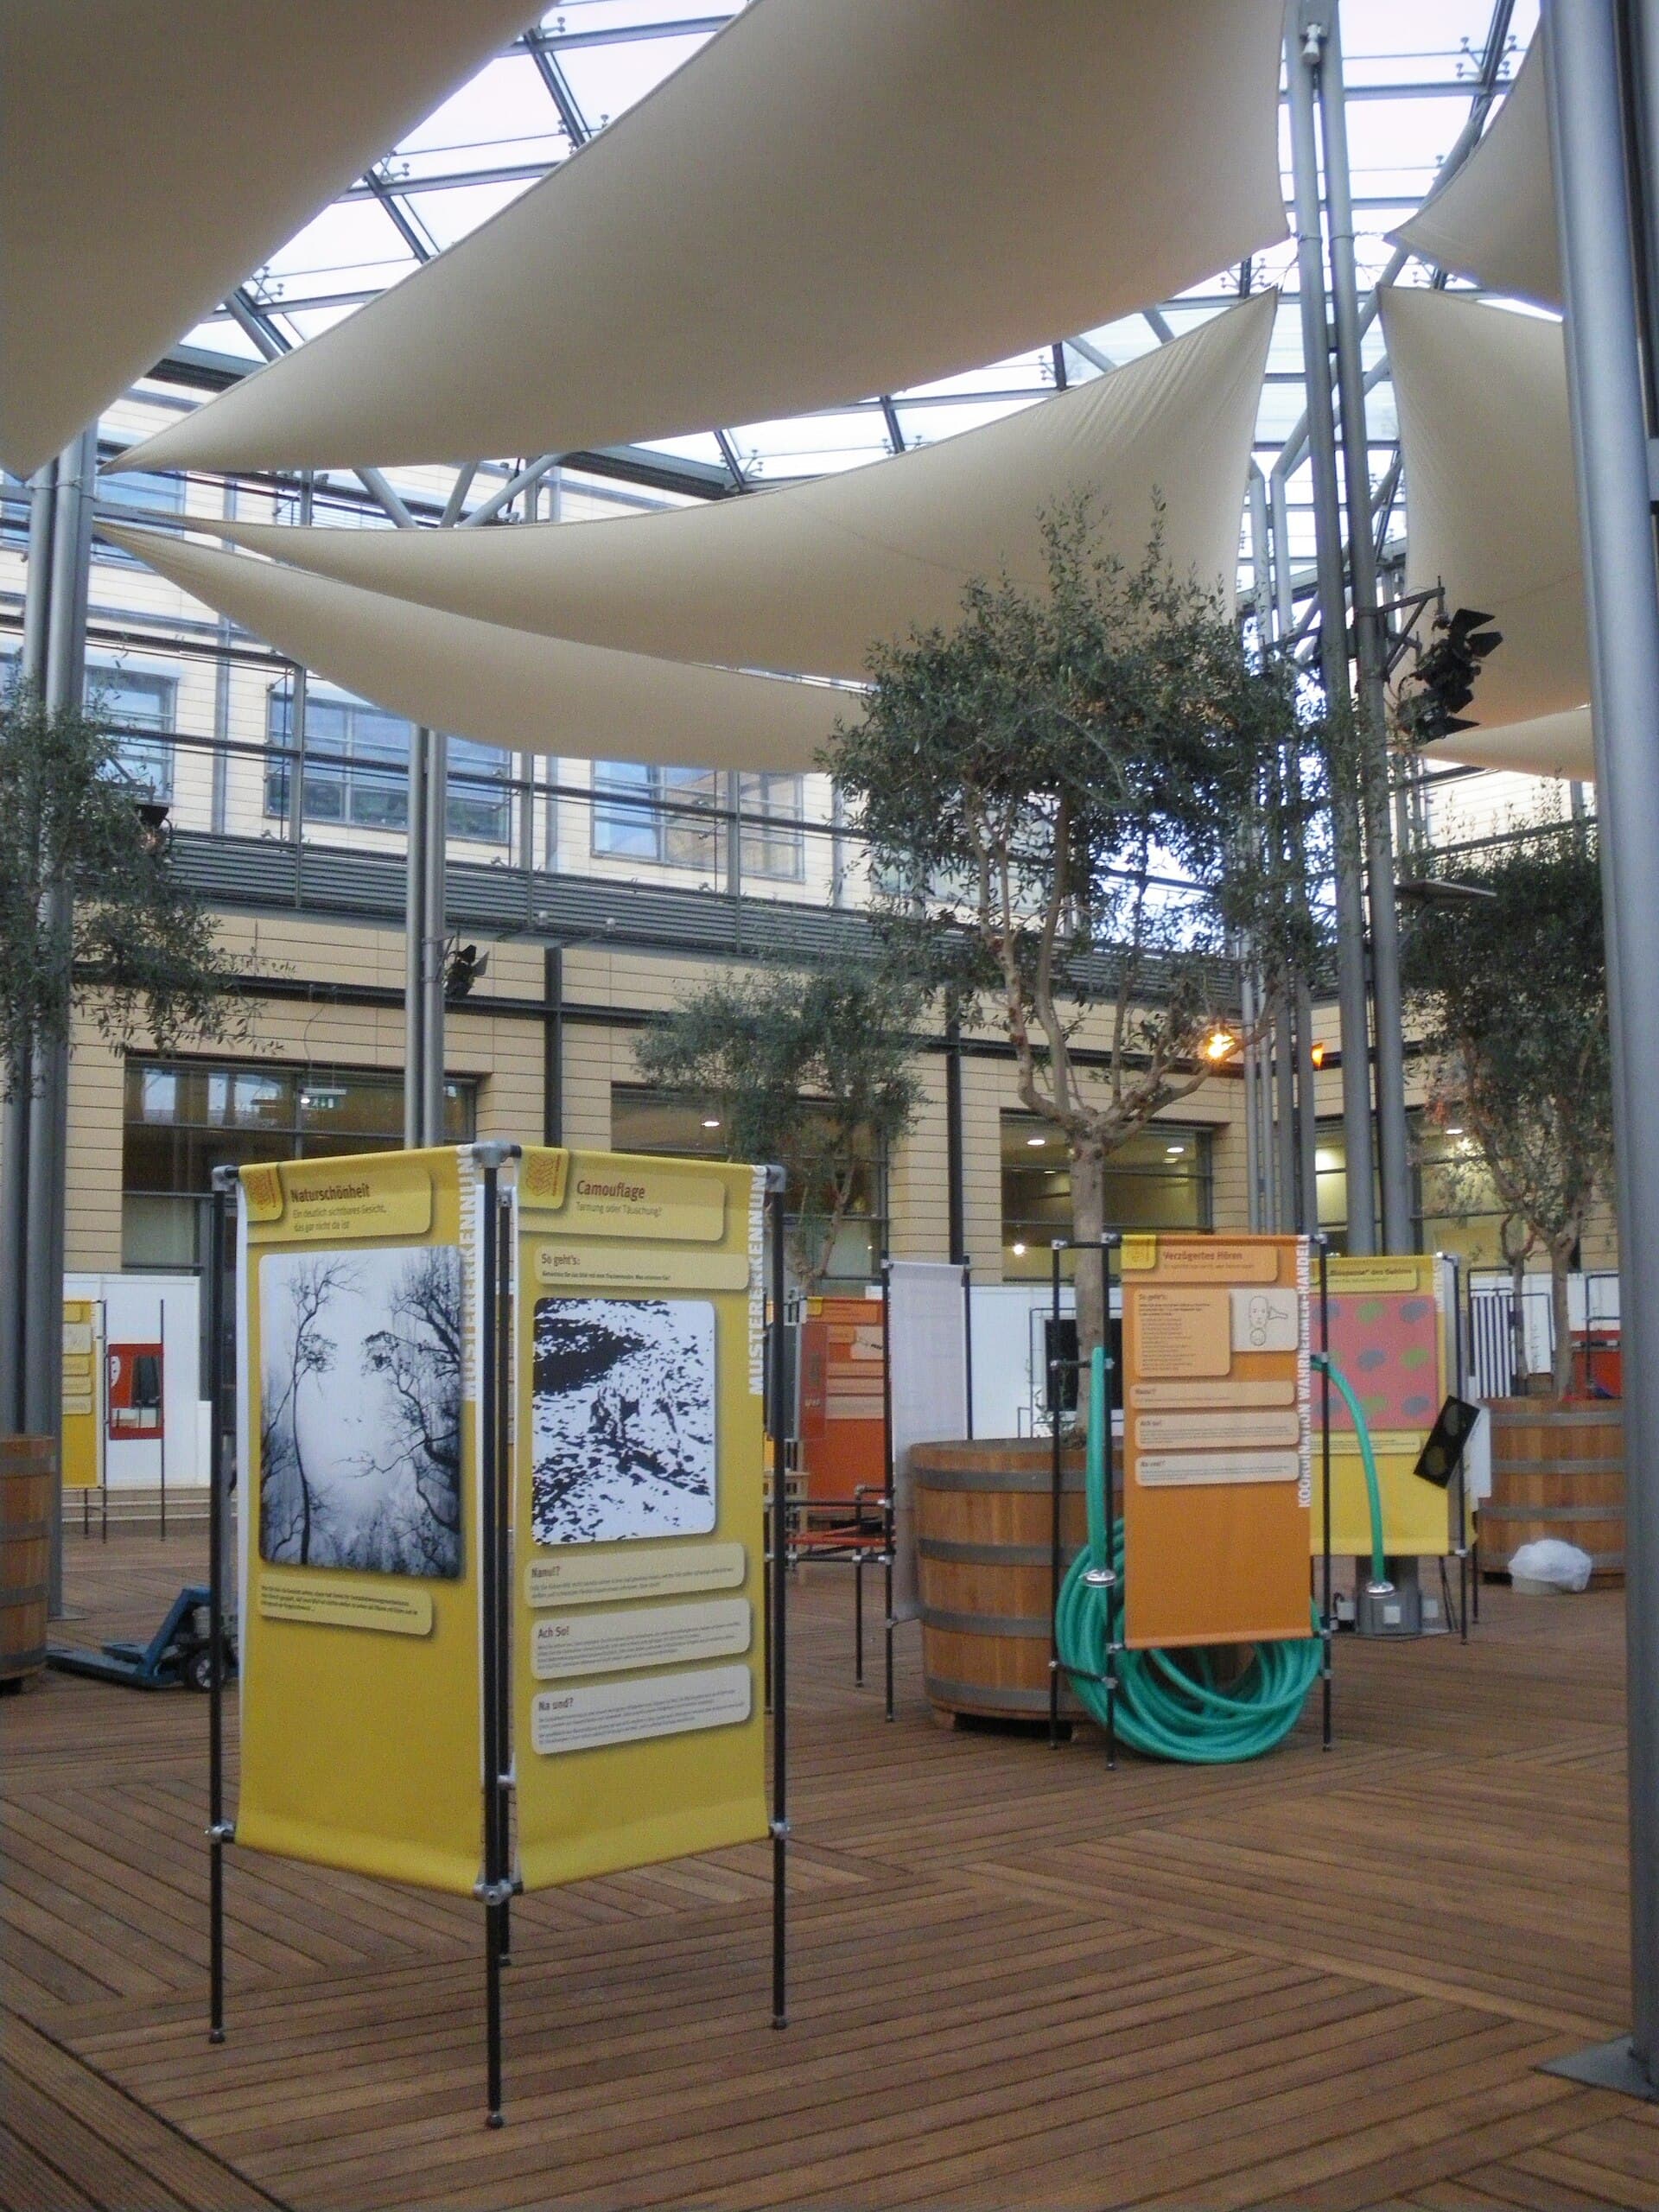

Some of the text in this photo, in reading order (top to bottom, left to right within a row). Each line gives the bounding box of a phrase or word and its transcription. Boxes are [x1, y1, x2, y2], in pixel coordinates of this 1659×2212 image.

[289, 1182, 370, 1203] Naturschönheit
[576, 1179, 645, 1202] Camouflage
[541, 1253, 552, 1264] So
[747, 1166, 766, 1395] MUSTERERKENNUNG
[537, 1627, 554, 1639] Ach
[538, 1696, 574, 1711] Na und?
